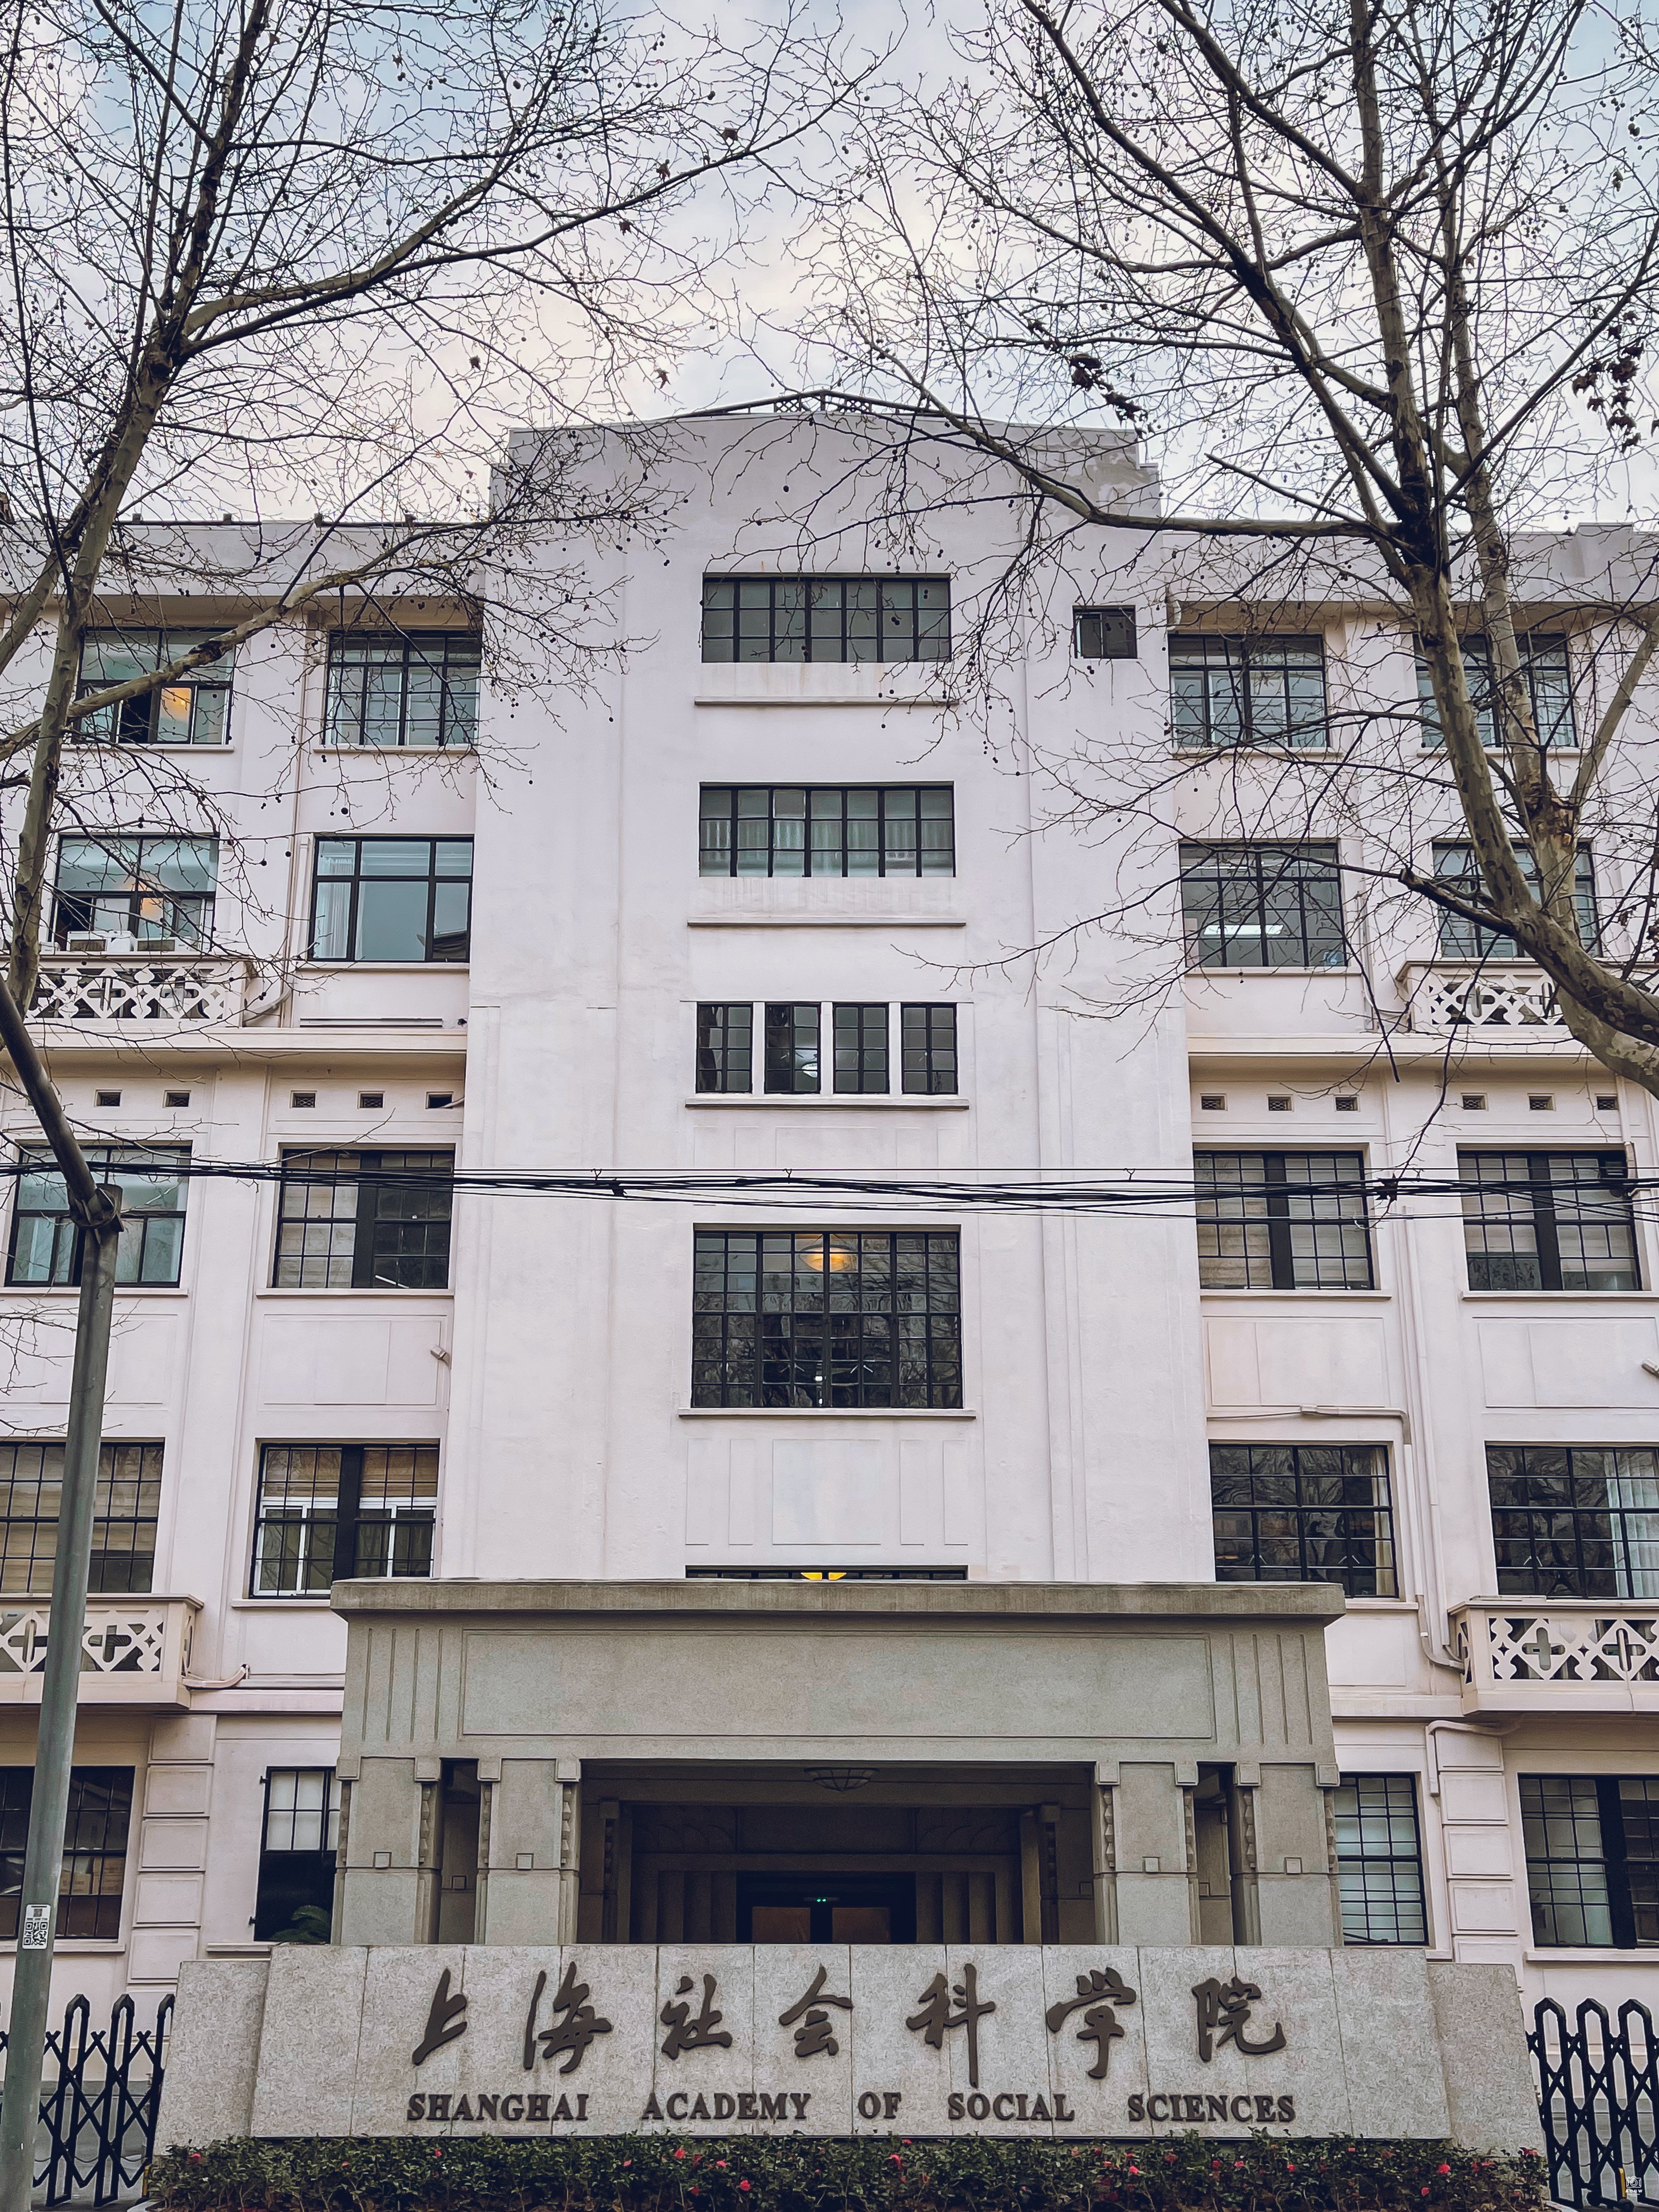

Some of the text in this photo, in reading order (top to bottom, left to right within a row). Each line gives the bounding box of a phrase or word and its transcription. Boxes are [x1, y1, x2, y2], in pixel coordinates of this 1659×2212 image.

[411, 1961, 1287, 2089] 上海社会科学院
[406, 2091, 1297, 2124] SHANGHAI ACADEMY OF SOCIAL SCIENCES
